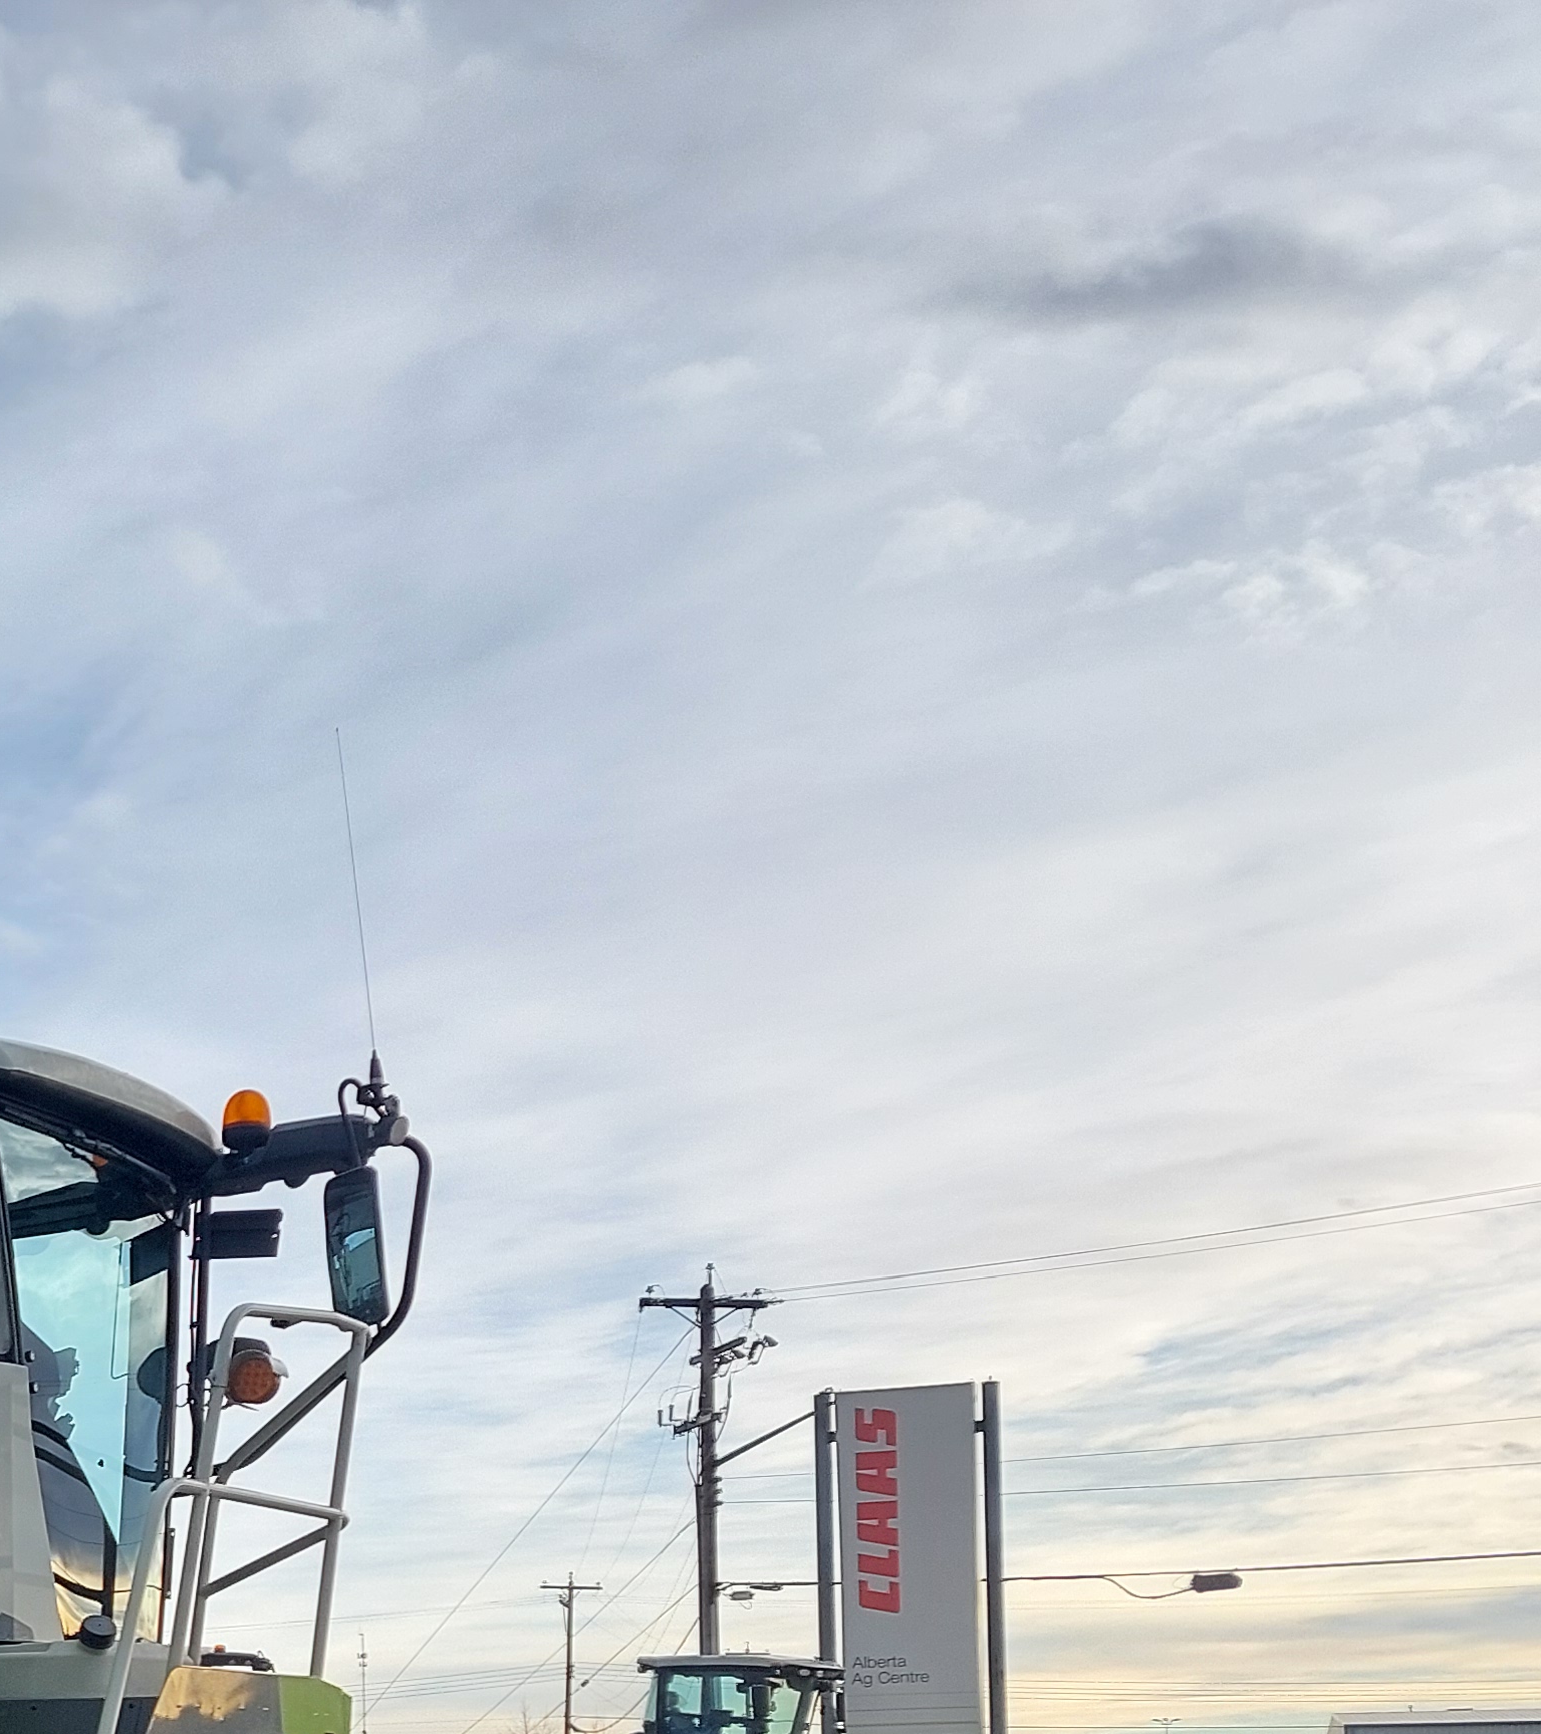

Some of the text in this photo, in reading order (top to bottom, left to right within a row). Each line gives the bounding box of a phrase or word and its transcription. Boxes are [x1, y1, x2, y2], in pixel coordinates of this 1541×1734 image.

[854, 1406, 902, 1614] CLAAS
[852, 1655, 908, 1670] Alberta
[852, 1670, 930, 1688] Ag Centre
